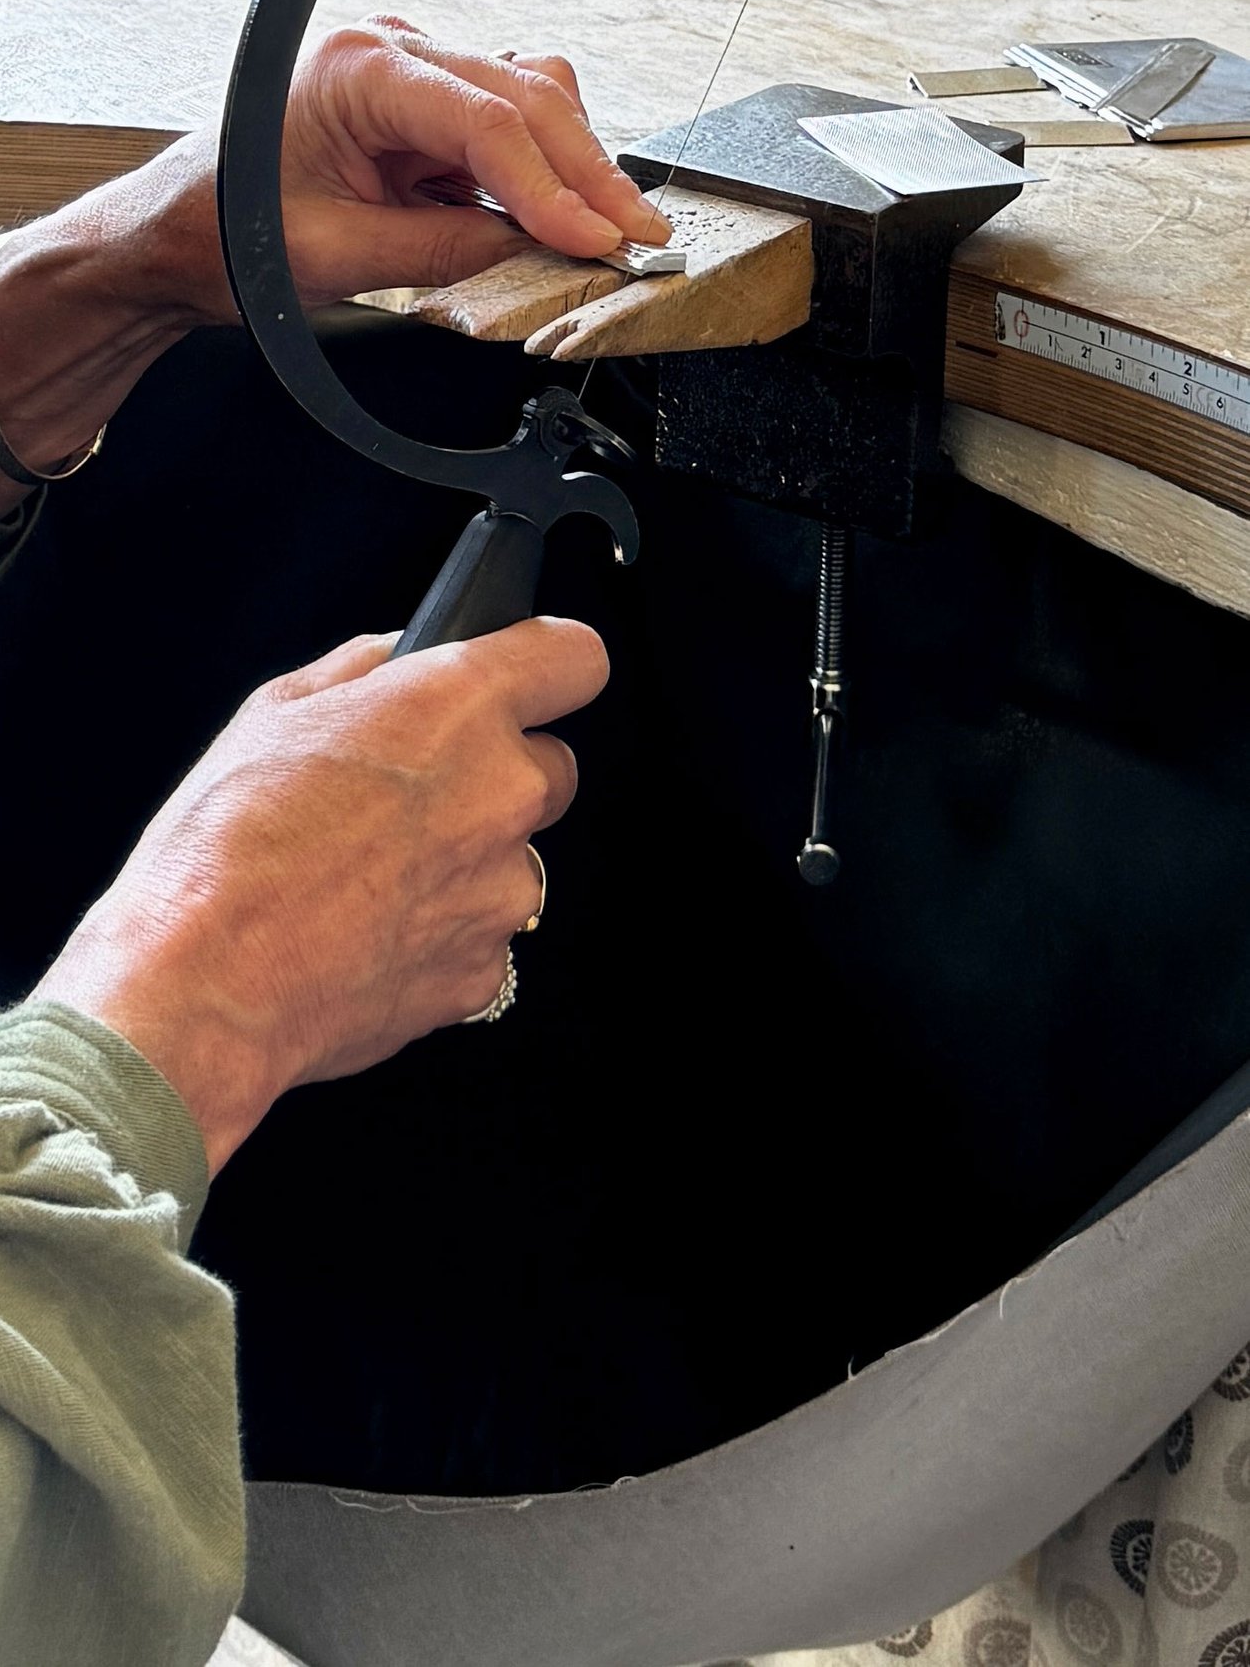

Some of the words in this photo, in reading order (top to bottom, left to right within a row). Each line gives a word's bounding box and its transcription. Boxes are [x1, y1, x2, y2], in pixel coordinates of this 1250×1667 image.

[1115, 357, 1123, 371] 3
[1148, 371, 1156, 383] 4
[1182, 382, 1190, 396] 5
[1216, 396, 1224, 409] 6
[1183, 361, 1193, 377] 2
